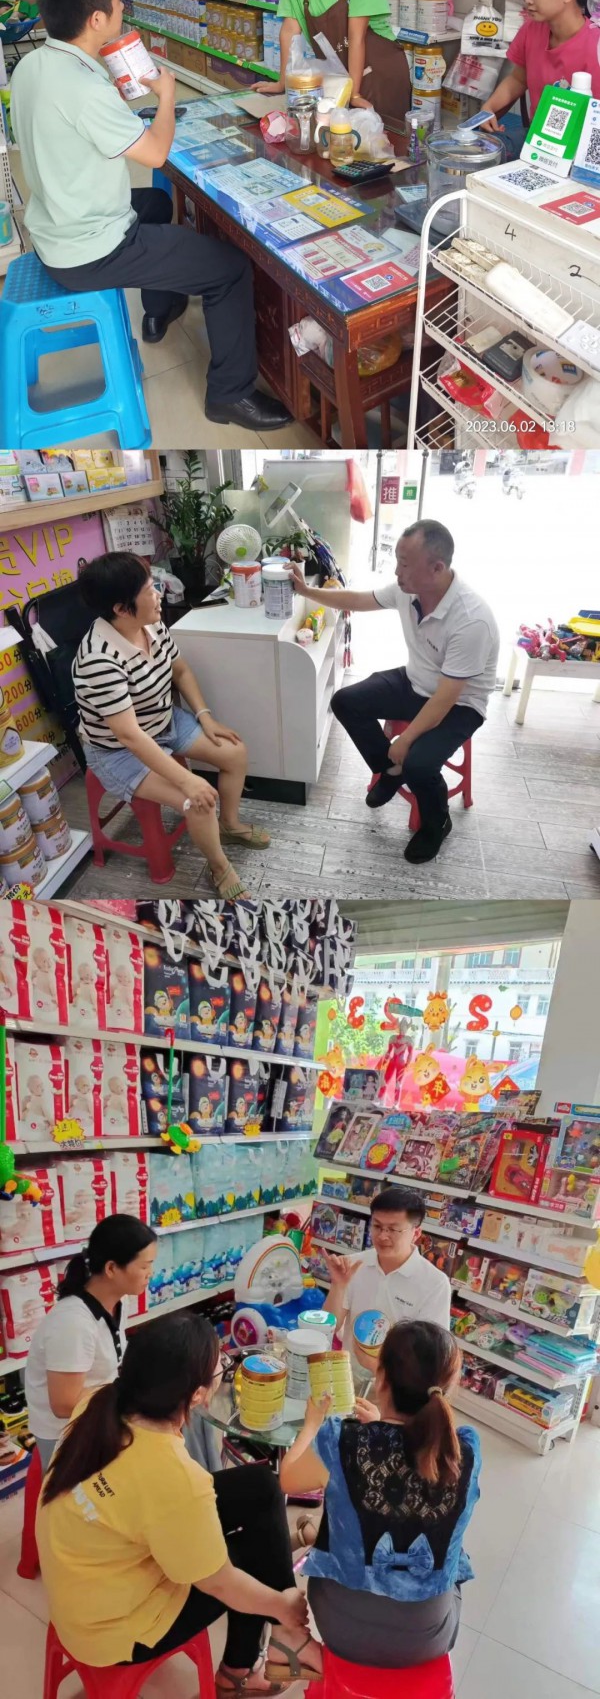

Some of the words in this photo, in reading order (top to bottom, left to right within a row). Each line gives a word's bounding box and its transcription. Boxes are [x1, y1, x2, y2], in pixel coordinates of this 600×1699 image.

[538, 155, 559, 169] 微信支付
[505, 223, 517, 241] 4
[383, 486, 397, 501] 推
[4, 679, 32, 704] 200分
[15, 707, 41, 732] 600分
[104, 1485, 115, 1497] LEFT
